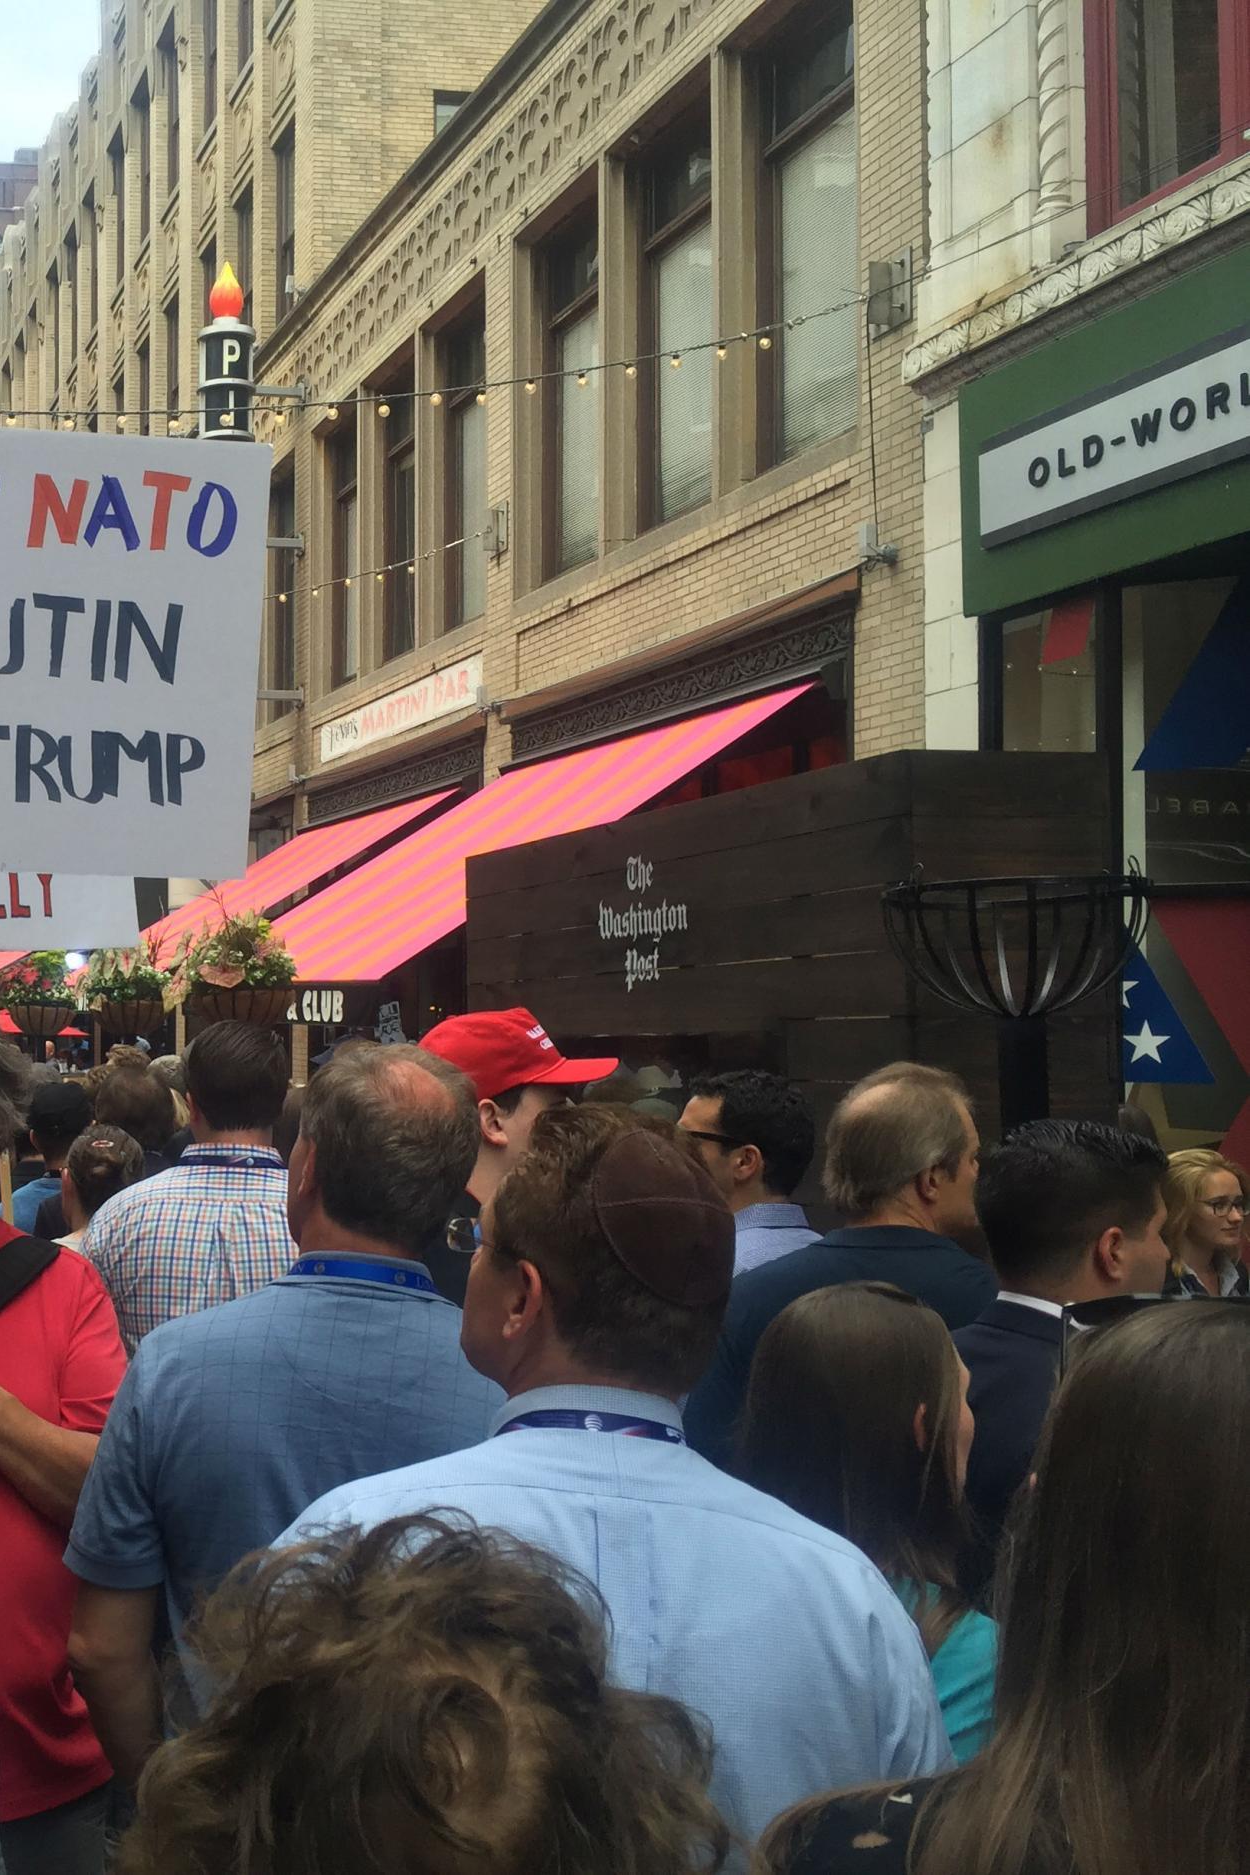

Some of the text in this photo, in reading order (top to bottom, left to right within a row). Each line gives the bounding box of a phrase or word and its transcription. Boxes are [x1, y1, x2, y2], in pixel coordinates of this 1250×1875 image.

[27, 471, 237, 557] NATO
[361, 687, 428, 740] MARTINI
[433, 669, 469, 708] BAR
[626, 855, 653, 894] The
[598, 898, 688, 942] Washington
[625, 947, 660, 992] Post
[302, 990, 344, 1023] CLUB
